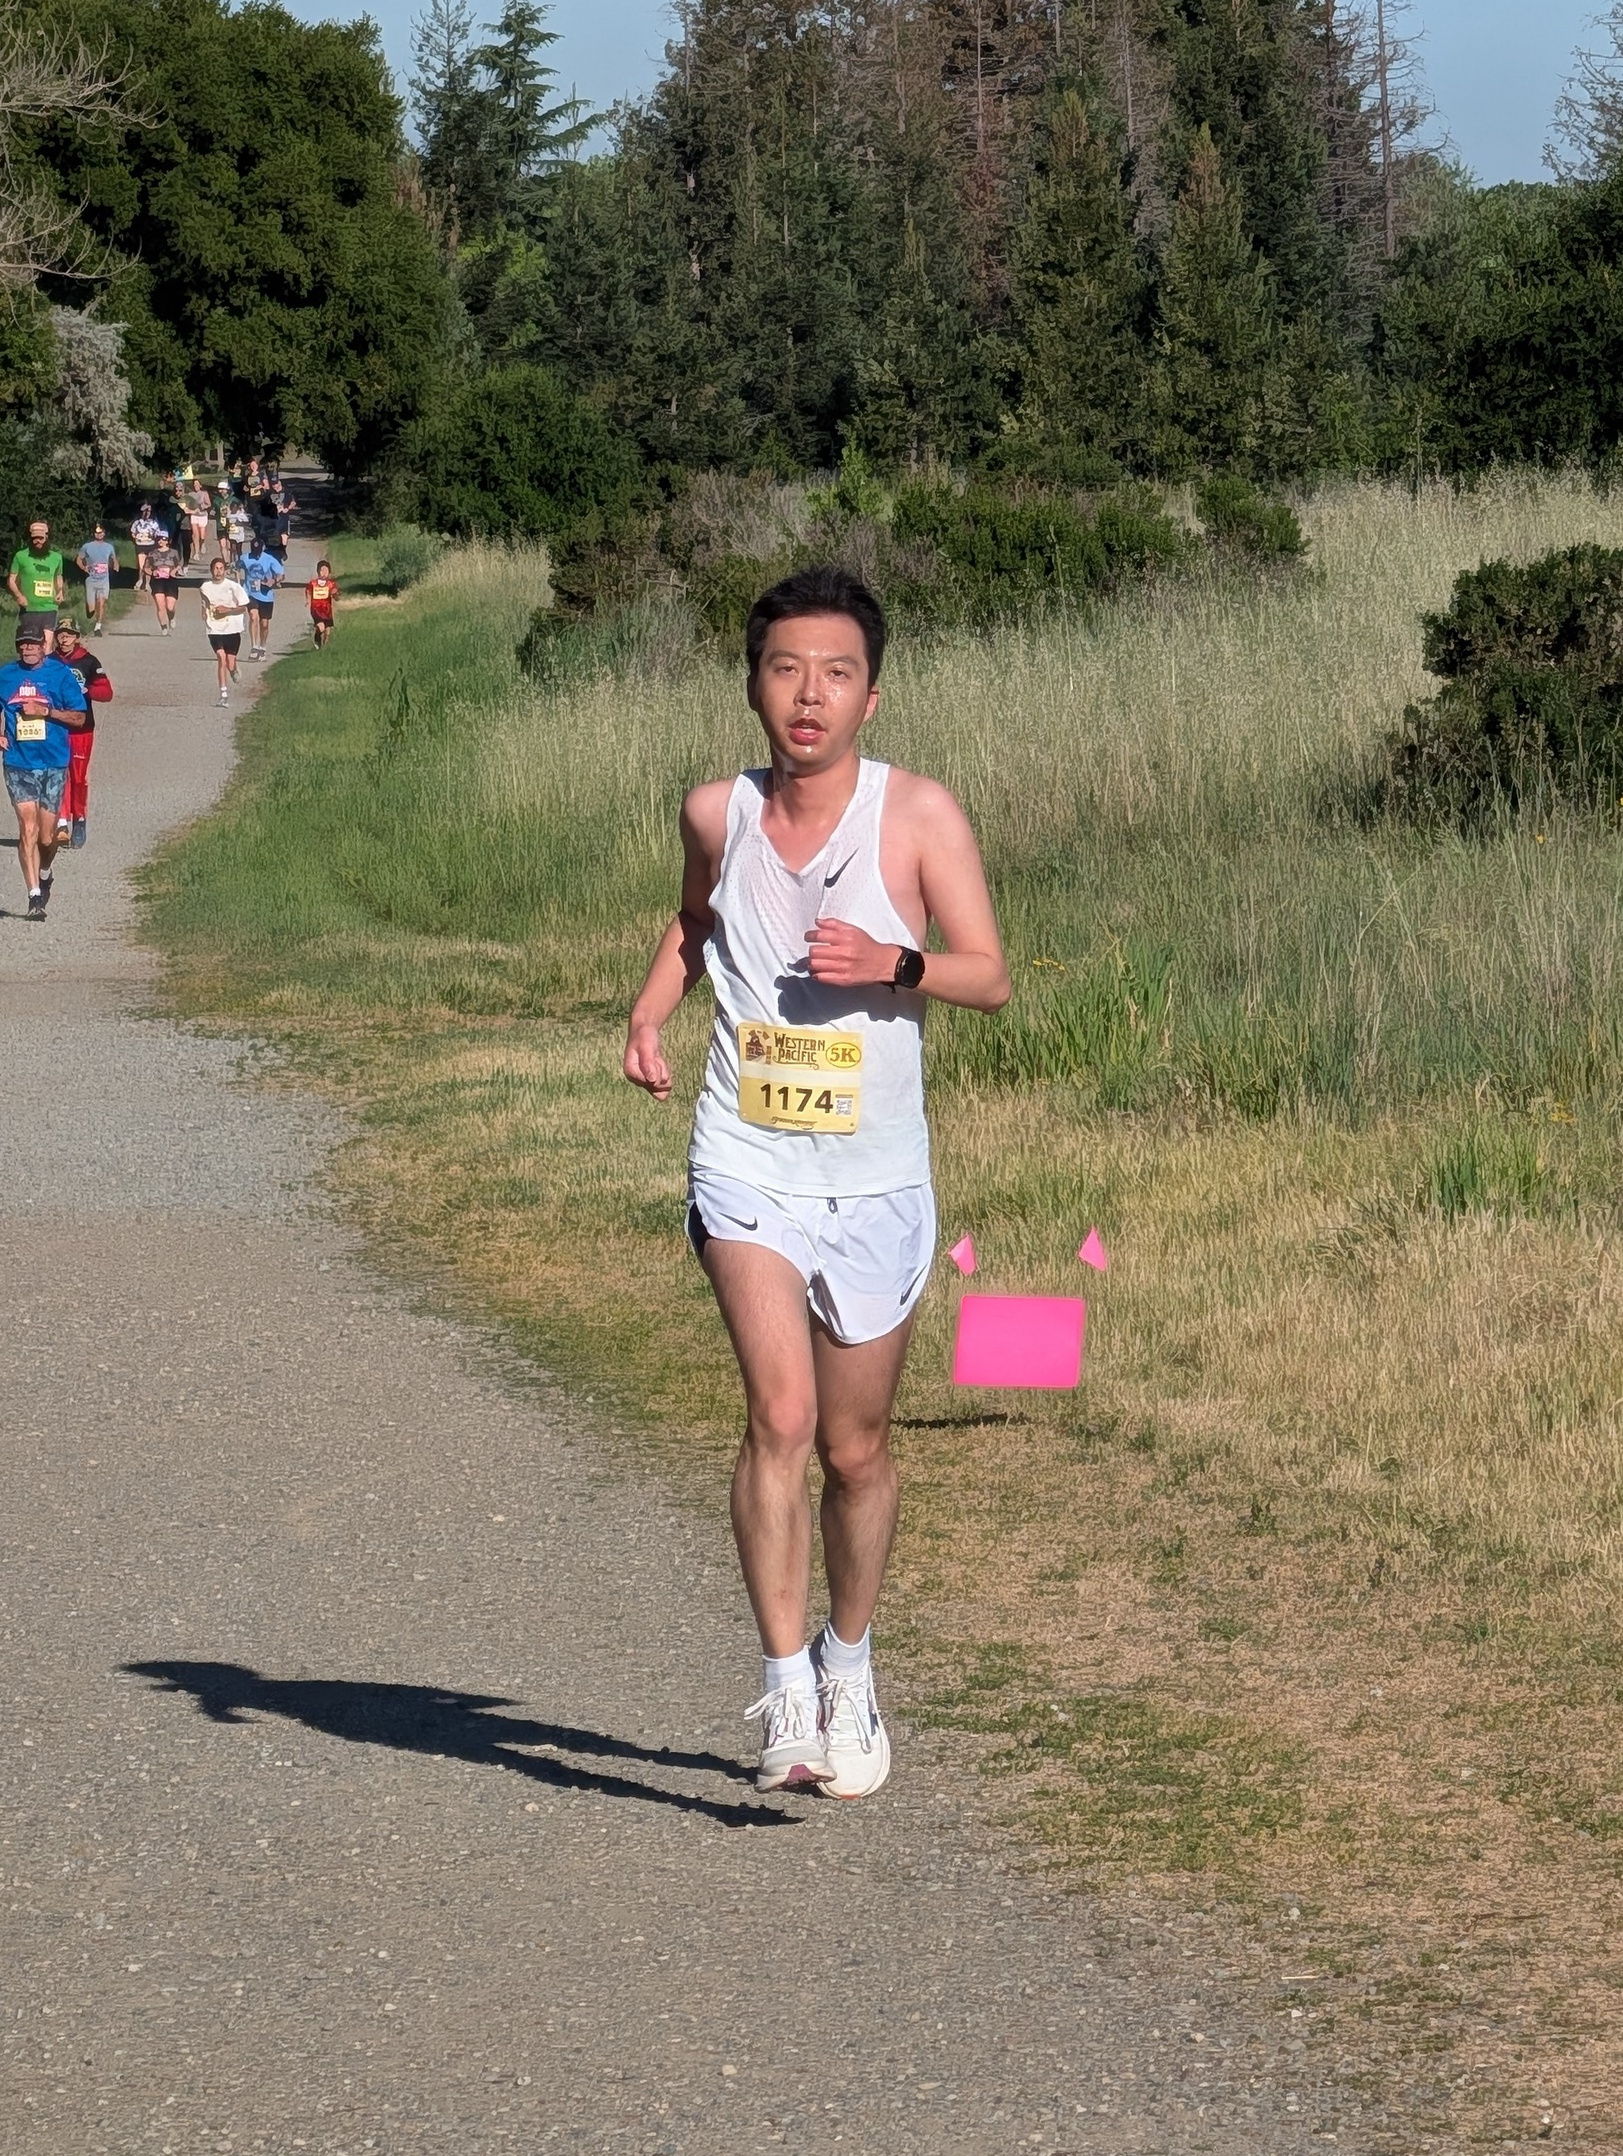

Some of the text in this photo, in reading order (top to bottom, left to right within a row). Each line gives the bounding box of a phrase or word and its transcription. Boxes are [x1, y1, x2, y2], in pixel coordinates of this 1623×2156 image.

[774, 1032, 825, 1051] WESTERN
[777, 1049, 818, 1063] PACIFIC
[830, 1048, 856, 1063] 5K
[760, 1083, 834, 1113] 1174
